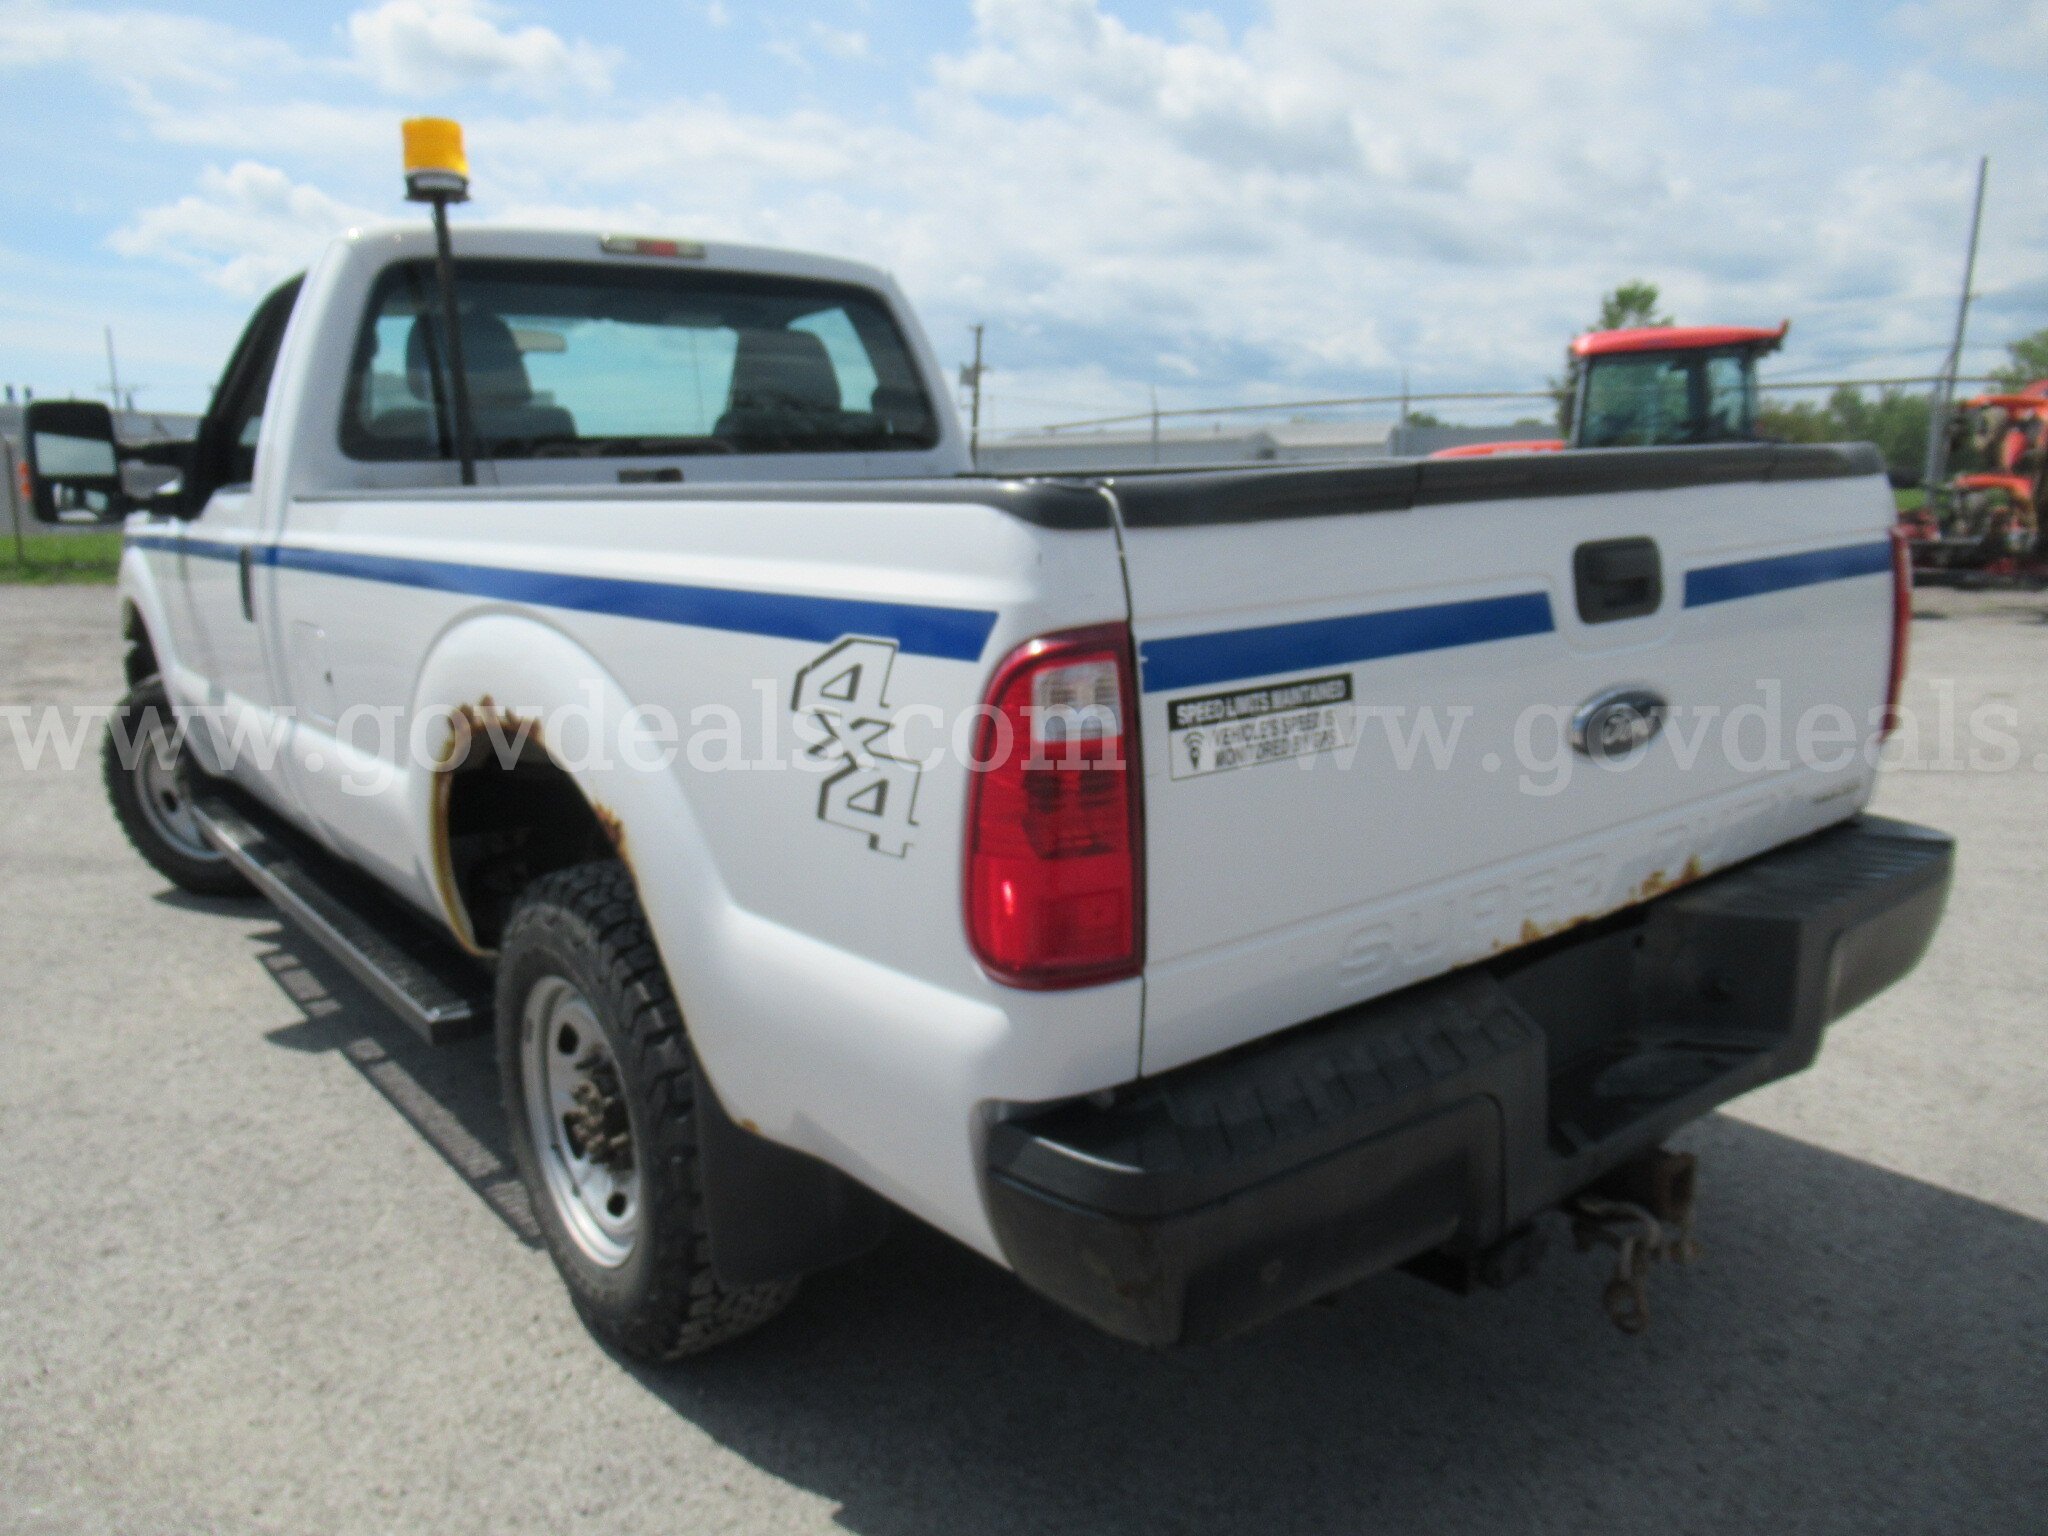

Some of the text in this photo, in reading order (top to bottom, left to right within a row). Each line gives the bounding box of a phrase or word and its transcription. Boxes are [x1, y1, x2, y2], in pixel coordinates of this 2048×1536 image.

[1177, 679, 1345, 725] SPEED LIMITS MAINTAINED
